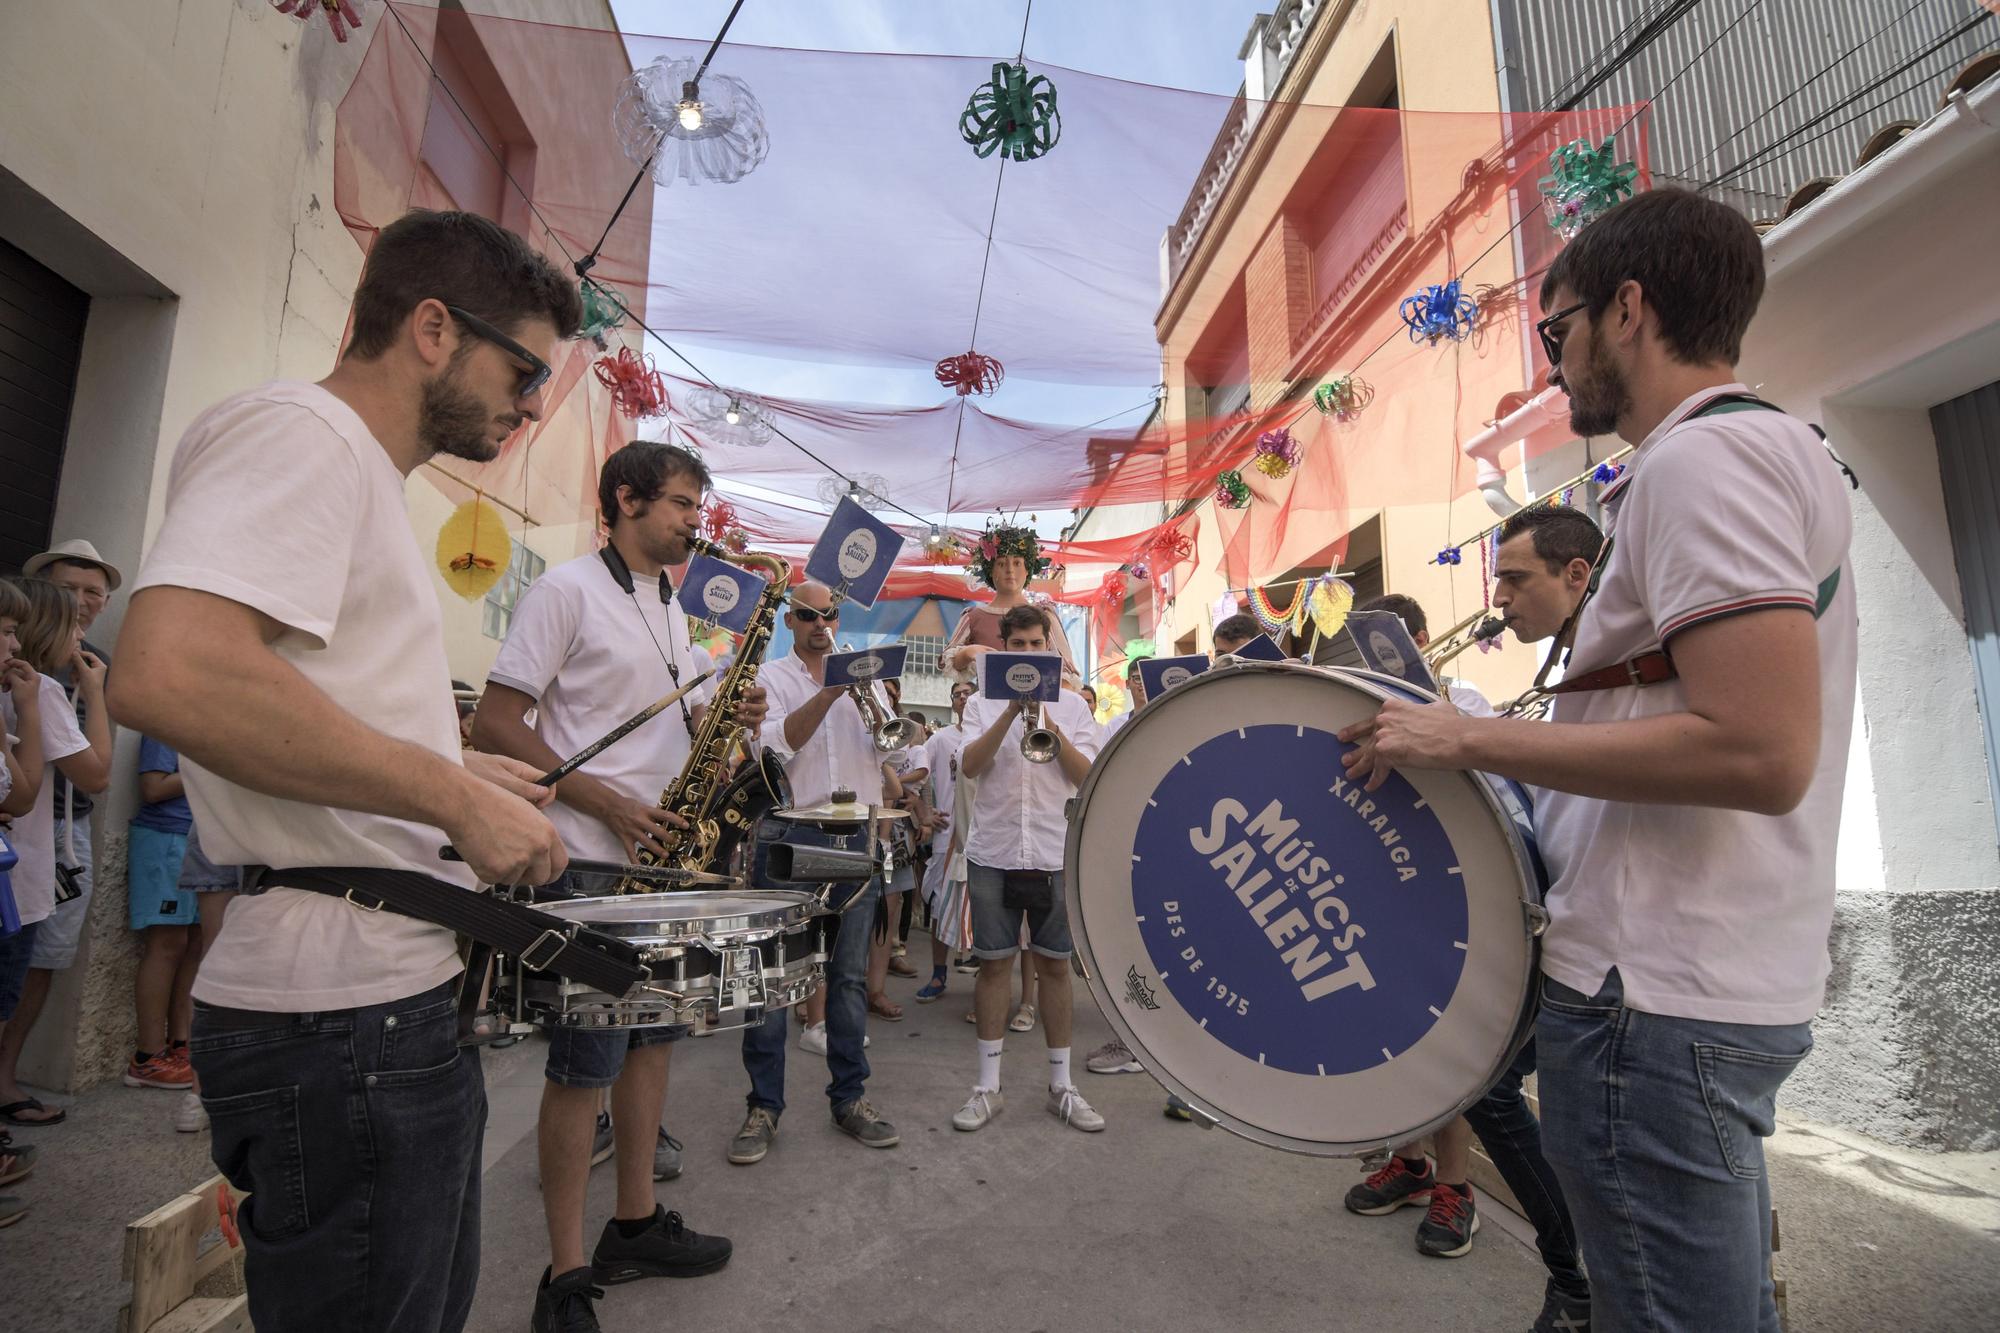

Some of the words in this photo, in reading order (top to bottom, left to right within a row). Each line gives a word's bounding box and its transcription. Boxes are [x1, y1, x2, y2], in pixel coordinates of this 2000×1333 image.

[1328, 775, 1418, 882] XARANGA
[1189, 797, 1377, 1002] SALLENT
[1284, 877, 1300, 894] DE
[1163, 901, 1186, 938] DES
[1180, 946, 1204, 973] DE
